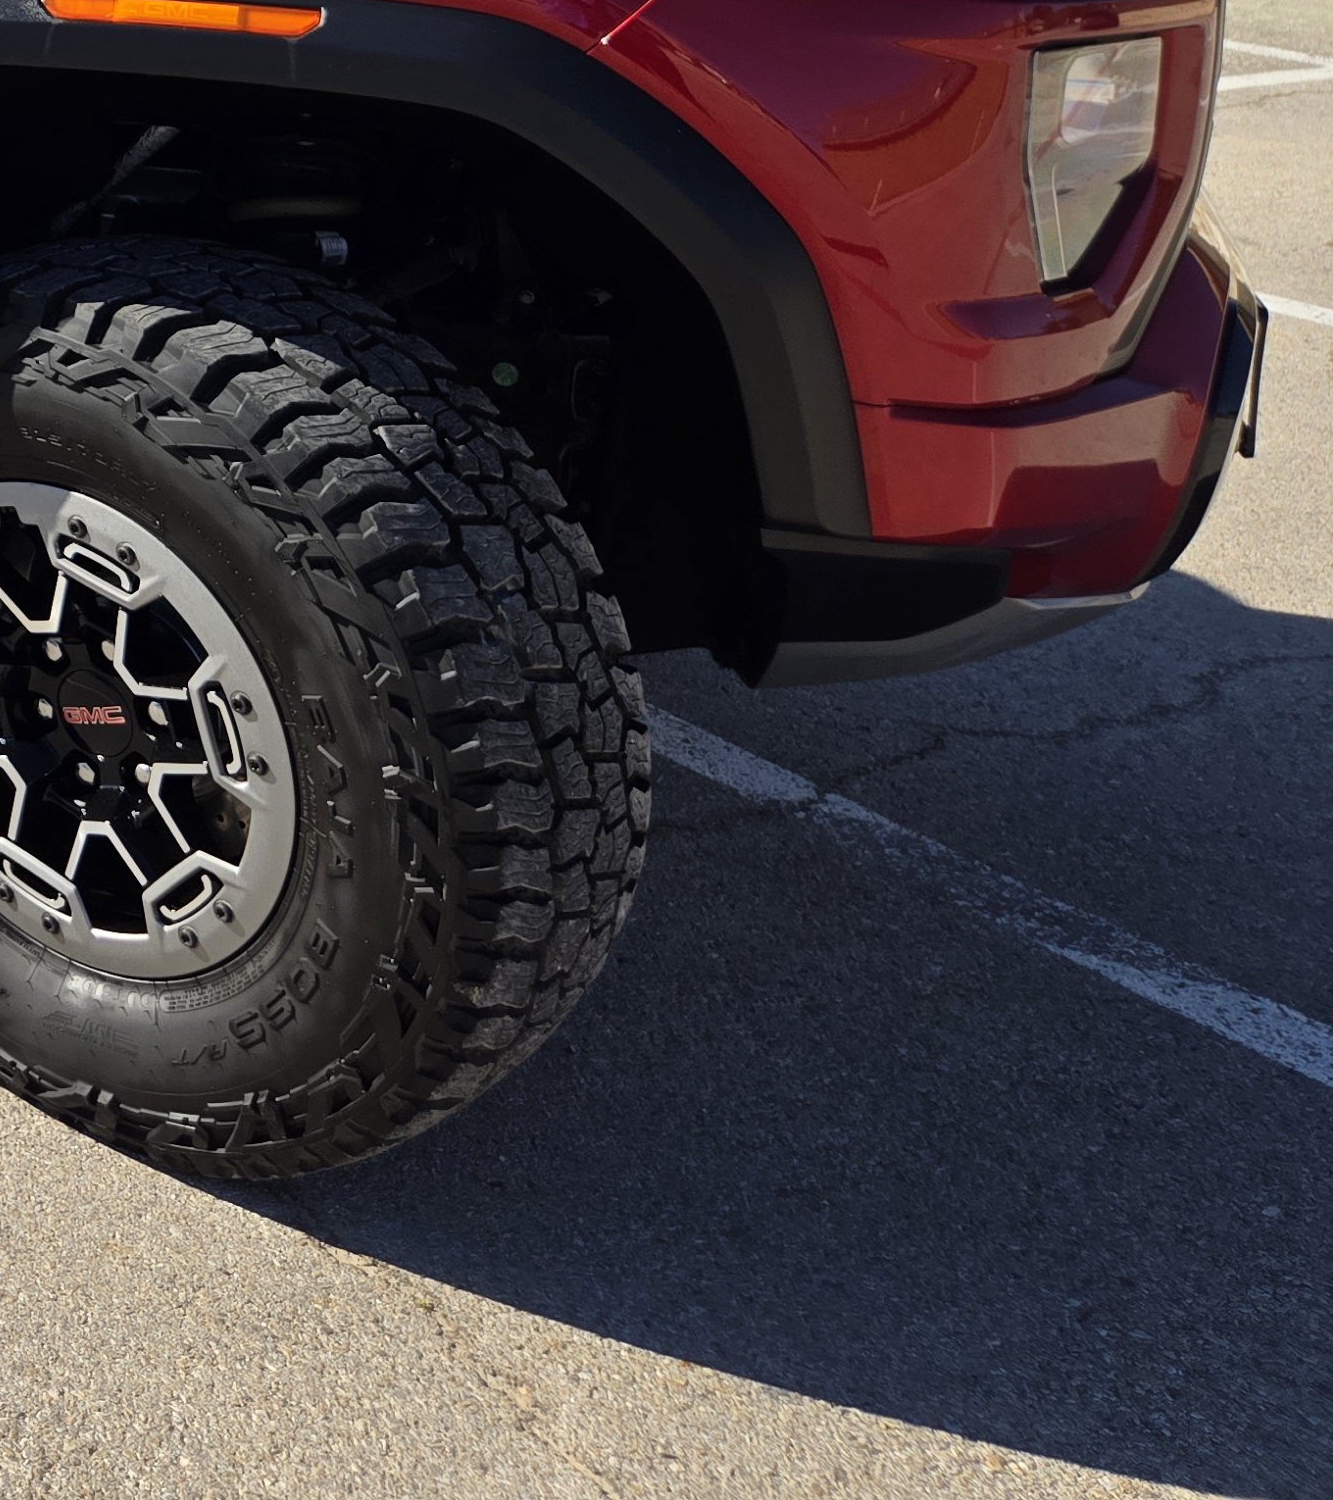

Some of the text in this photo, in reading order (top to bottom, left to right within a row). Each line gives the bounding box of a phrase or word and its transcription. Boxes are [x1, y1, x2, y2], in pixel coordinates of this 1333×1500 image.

[62, 705, 126, 725] GMC
[301, 694, 355, 879] BAJA
[228, 917, 340, 1050] BOSS
